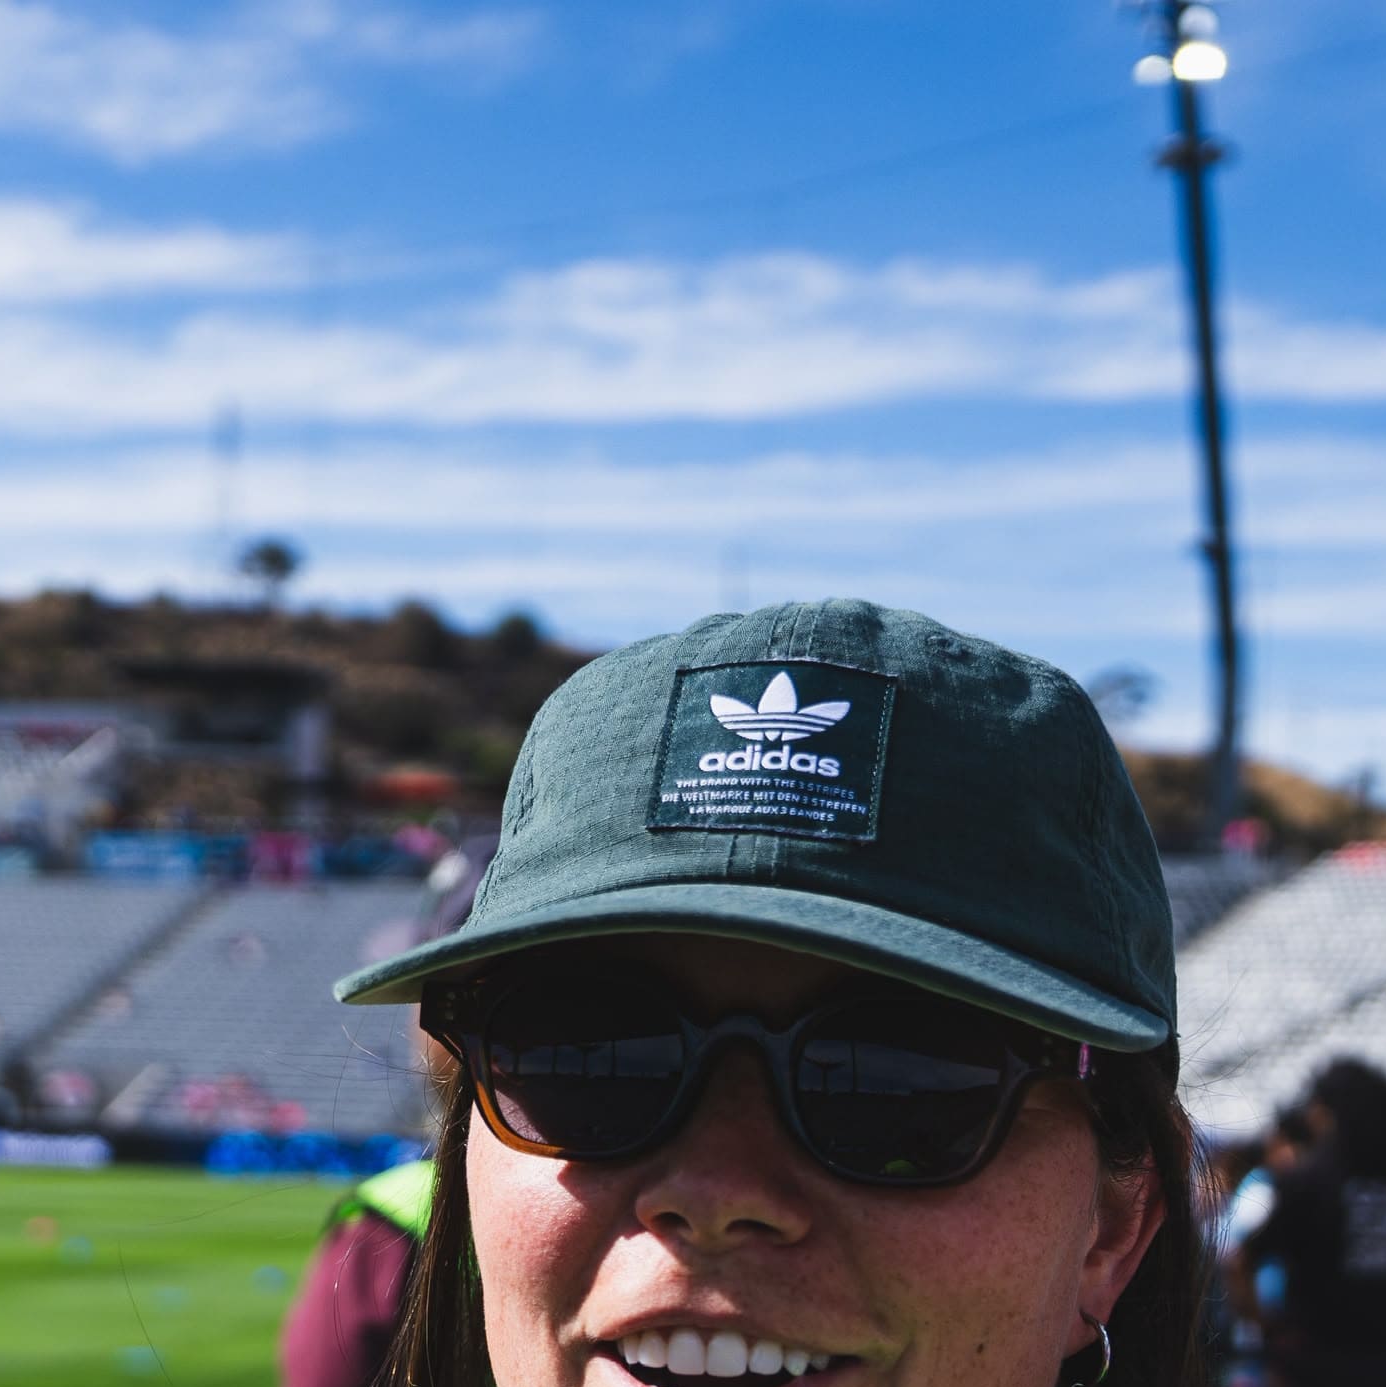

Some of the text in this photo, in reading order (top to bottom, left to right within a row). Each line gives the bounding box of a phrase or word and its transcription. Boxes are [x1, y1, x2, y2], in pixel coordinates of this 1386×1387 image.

[698, 743, 840, 778] adidas
[676, 777, 855, 800] THE BRAND WITH THE 3 STRIPES
[661, 790, 867, 815] DIE WELTMARKE MIT DEN 3 STREIFEN
[689, 805, 835, 822] LA MARQUE AUX 3 BANDES
